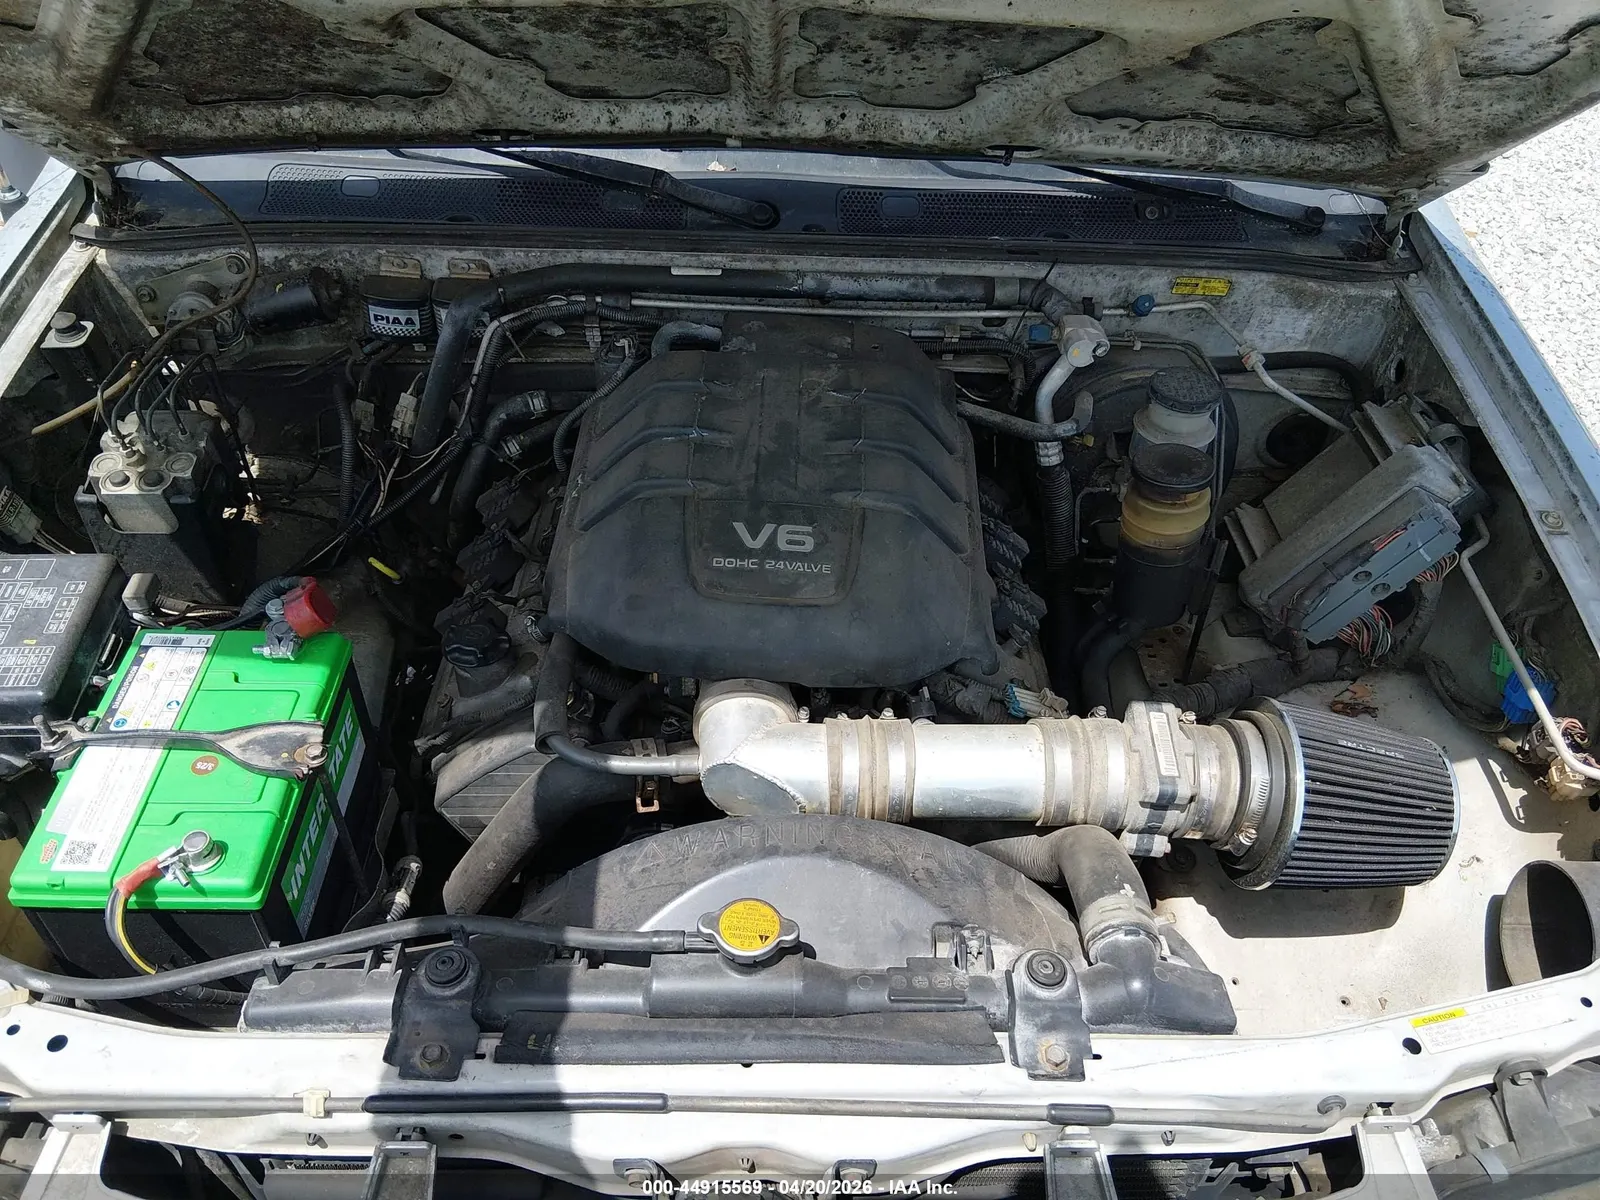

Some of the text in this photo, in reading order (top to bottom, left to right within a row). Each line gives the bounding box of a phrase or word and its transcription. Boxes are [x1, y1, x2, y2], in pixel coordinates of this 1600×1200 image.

[373, 313, 416, 326] PIAA
[732, 521, 815, 553] V6
[712, 557, 759, 568] DOHC
[195, 760, 215, 771] 3/25
[290, 707, 354, 900] INTERTATE
[675, 821, 854, 856] WARNING
[1421, 1012, 1457, 1025] CAUTION
